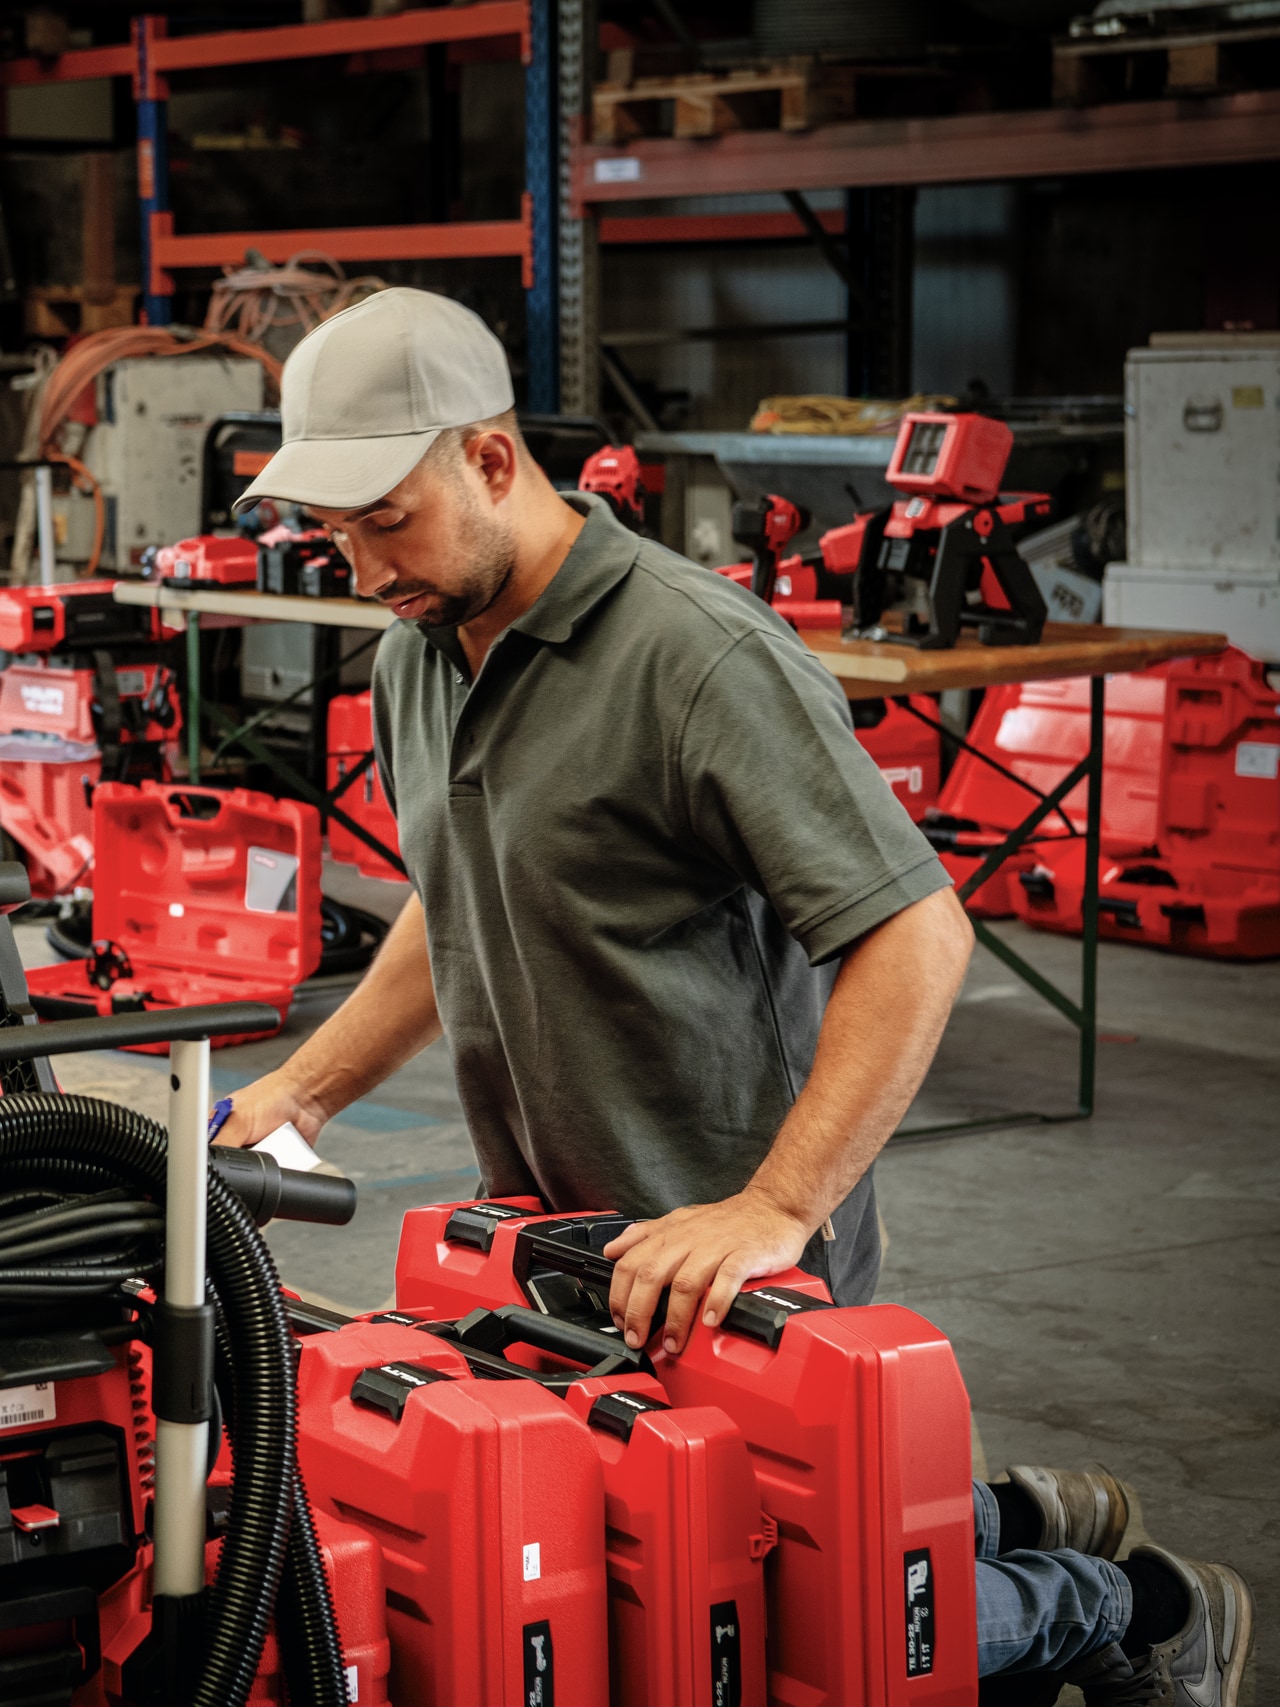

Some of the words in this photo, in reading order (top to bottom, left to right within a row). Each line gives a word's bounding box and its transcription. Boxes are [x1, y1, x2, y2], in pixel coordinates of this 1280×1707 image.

[471, 1206, 512, 1218] HILTI
[752, 1291, 802, 1310] HILTI
[383, 1313, 413, 1324] HILTI
[380, 1365, 427, 1386] HILTI
[610, 1393, 647, 1410] HILTI
[907, 1623, 916, 1656] 30-22
[908, 1656, 917, 1671] TE
